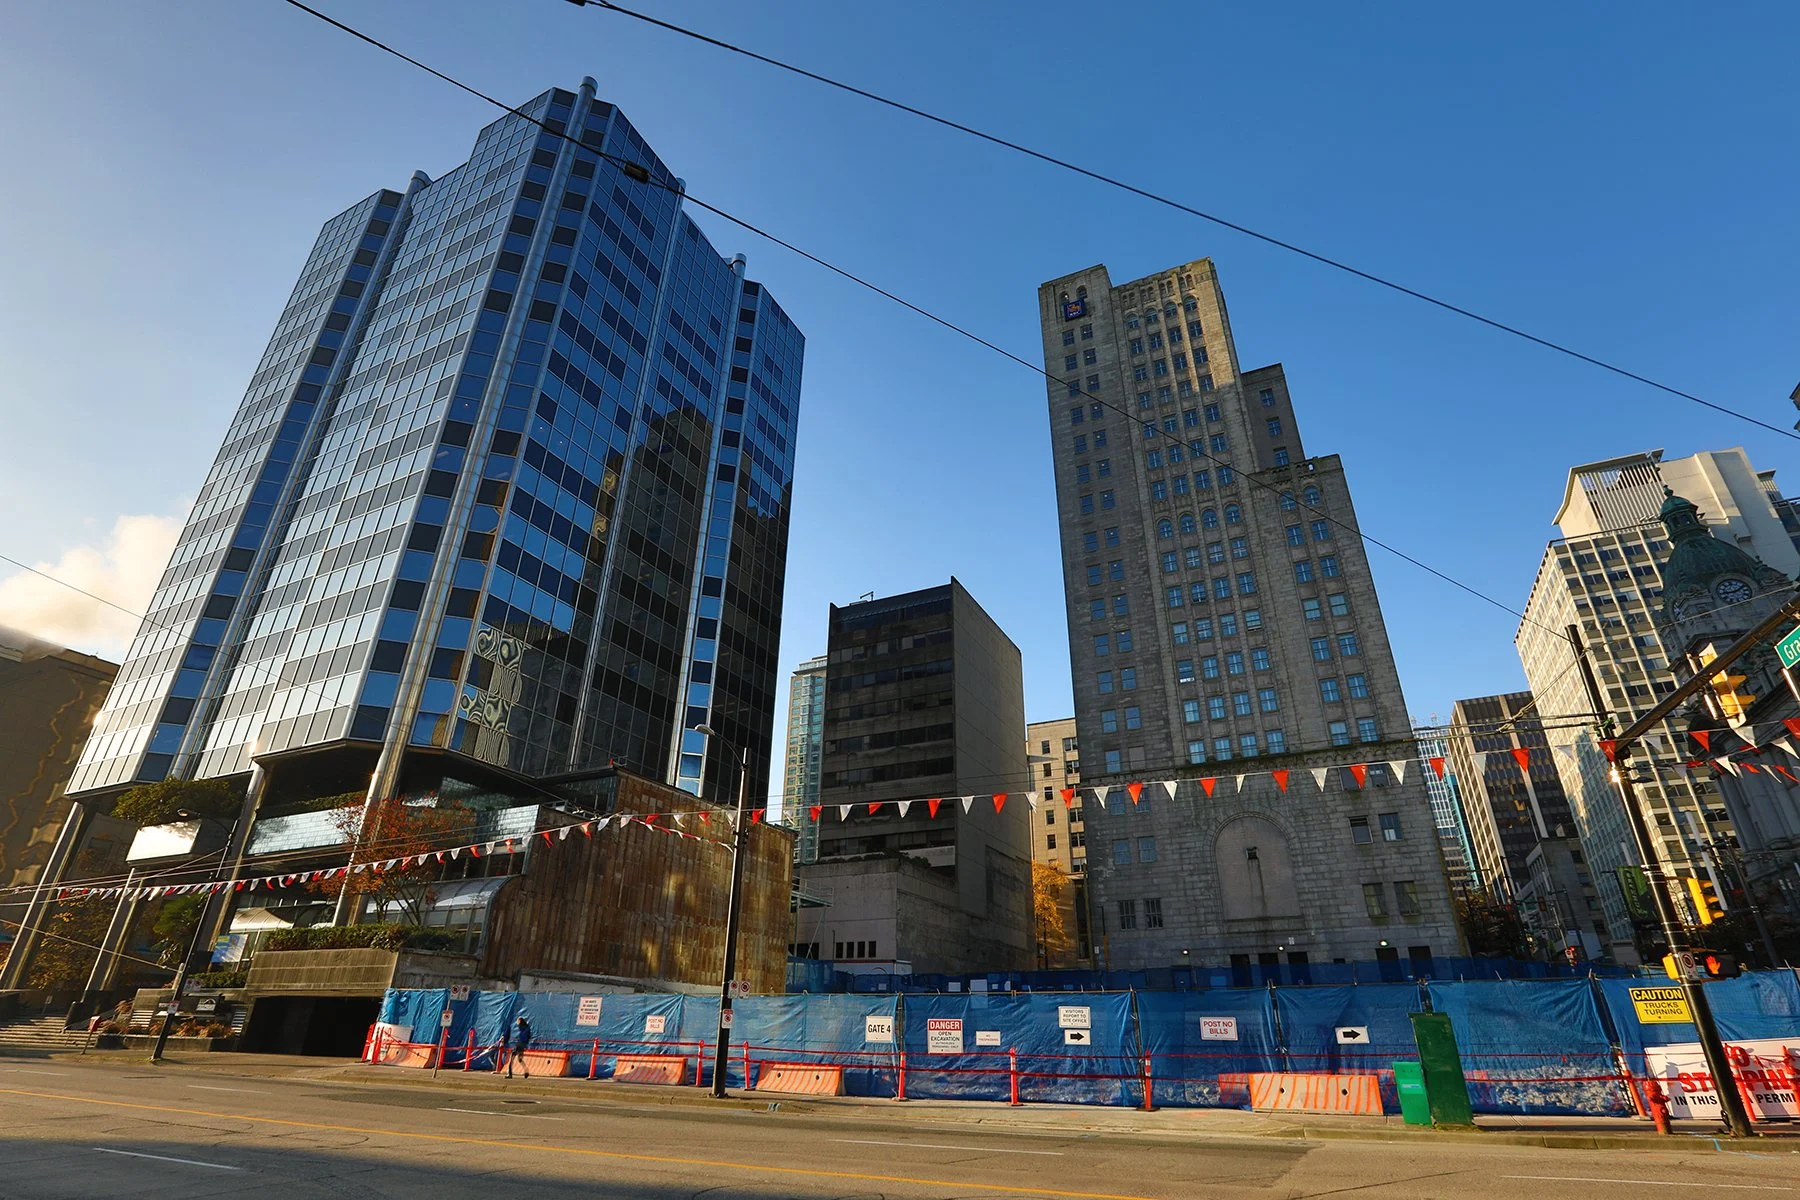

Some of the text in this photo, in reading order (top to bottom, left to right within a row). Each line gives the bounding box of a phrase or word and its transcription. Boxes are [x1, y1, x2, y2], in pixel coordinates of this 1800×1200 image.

[1633, 989, 1683, 1000] CAUTION
[868, 1024, 891, 1034] GATE 4
[930, 1021, 960, 1030] DANGER
[1675, 1096, 1687, 1106] IN
[1689, 1095, 1718, 1105] THIS
